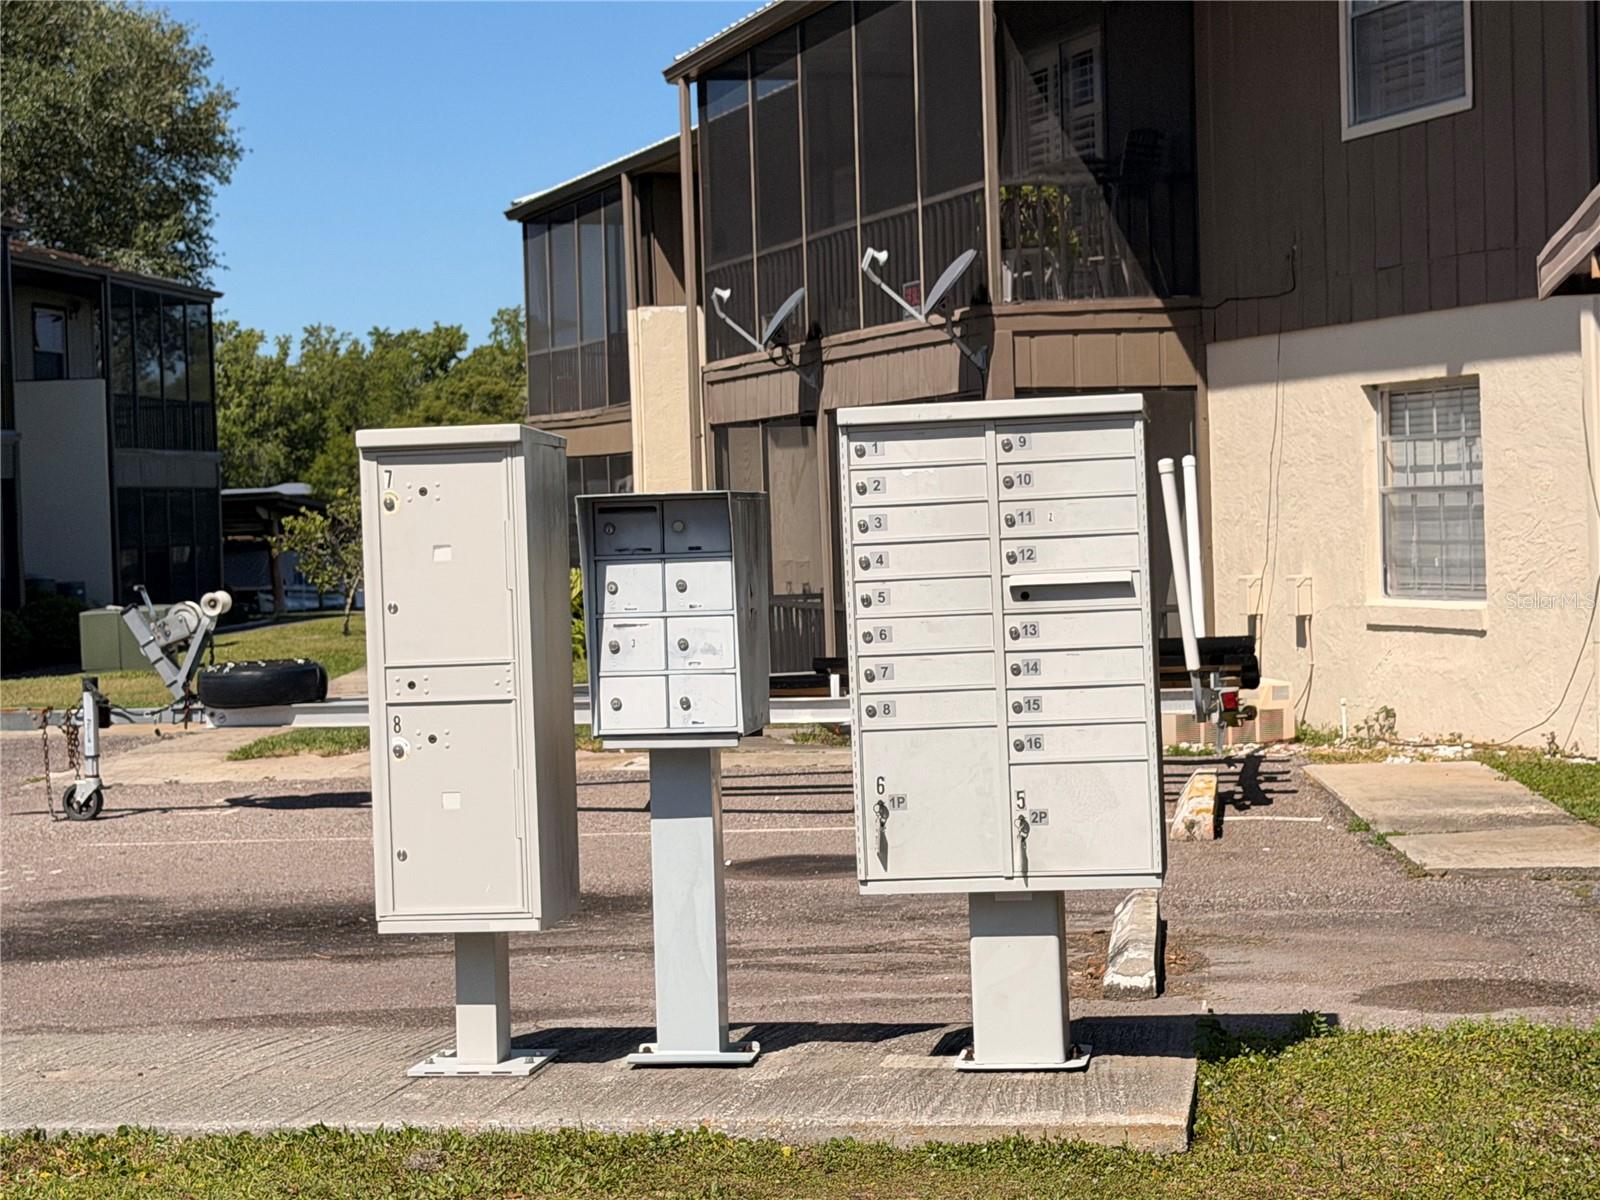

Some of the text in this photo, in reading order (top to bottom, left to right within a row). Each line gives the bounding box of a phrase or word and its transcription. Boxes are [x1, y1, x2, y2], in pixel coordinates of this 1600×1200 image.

[1018, 435, 1026, 447] 9
[384, 469, 392, 488] 7
[1016, 473, 1031, 485] 10
[873, 479, 881, 491] 2
[874, 516, 882, 528] 3
[1018, 511, 1032, 523] 11
[876, 554, 884, 566] 4
[1019, 548, 1034, 560] 12
[877, 591, 885, 603] 5
[879, 628, 887, 640] 6
[1022, 624, 1037, 636] 13
[880, 666, 888, 678] 7
[1024, 662, 1038, 673] 14
[882, 703, 891, 715] 8
[1025, 699, 1040, 711] 15
[393, 715, 401, 733] 8
[1026, 737, 1042, 749] 16
[876, 776, 884, 795] 6
[890, 796, 905, 808] 1P
[1016, 790, 1025, 809] 5
[1031, 811, 1047, 823] 2P
